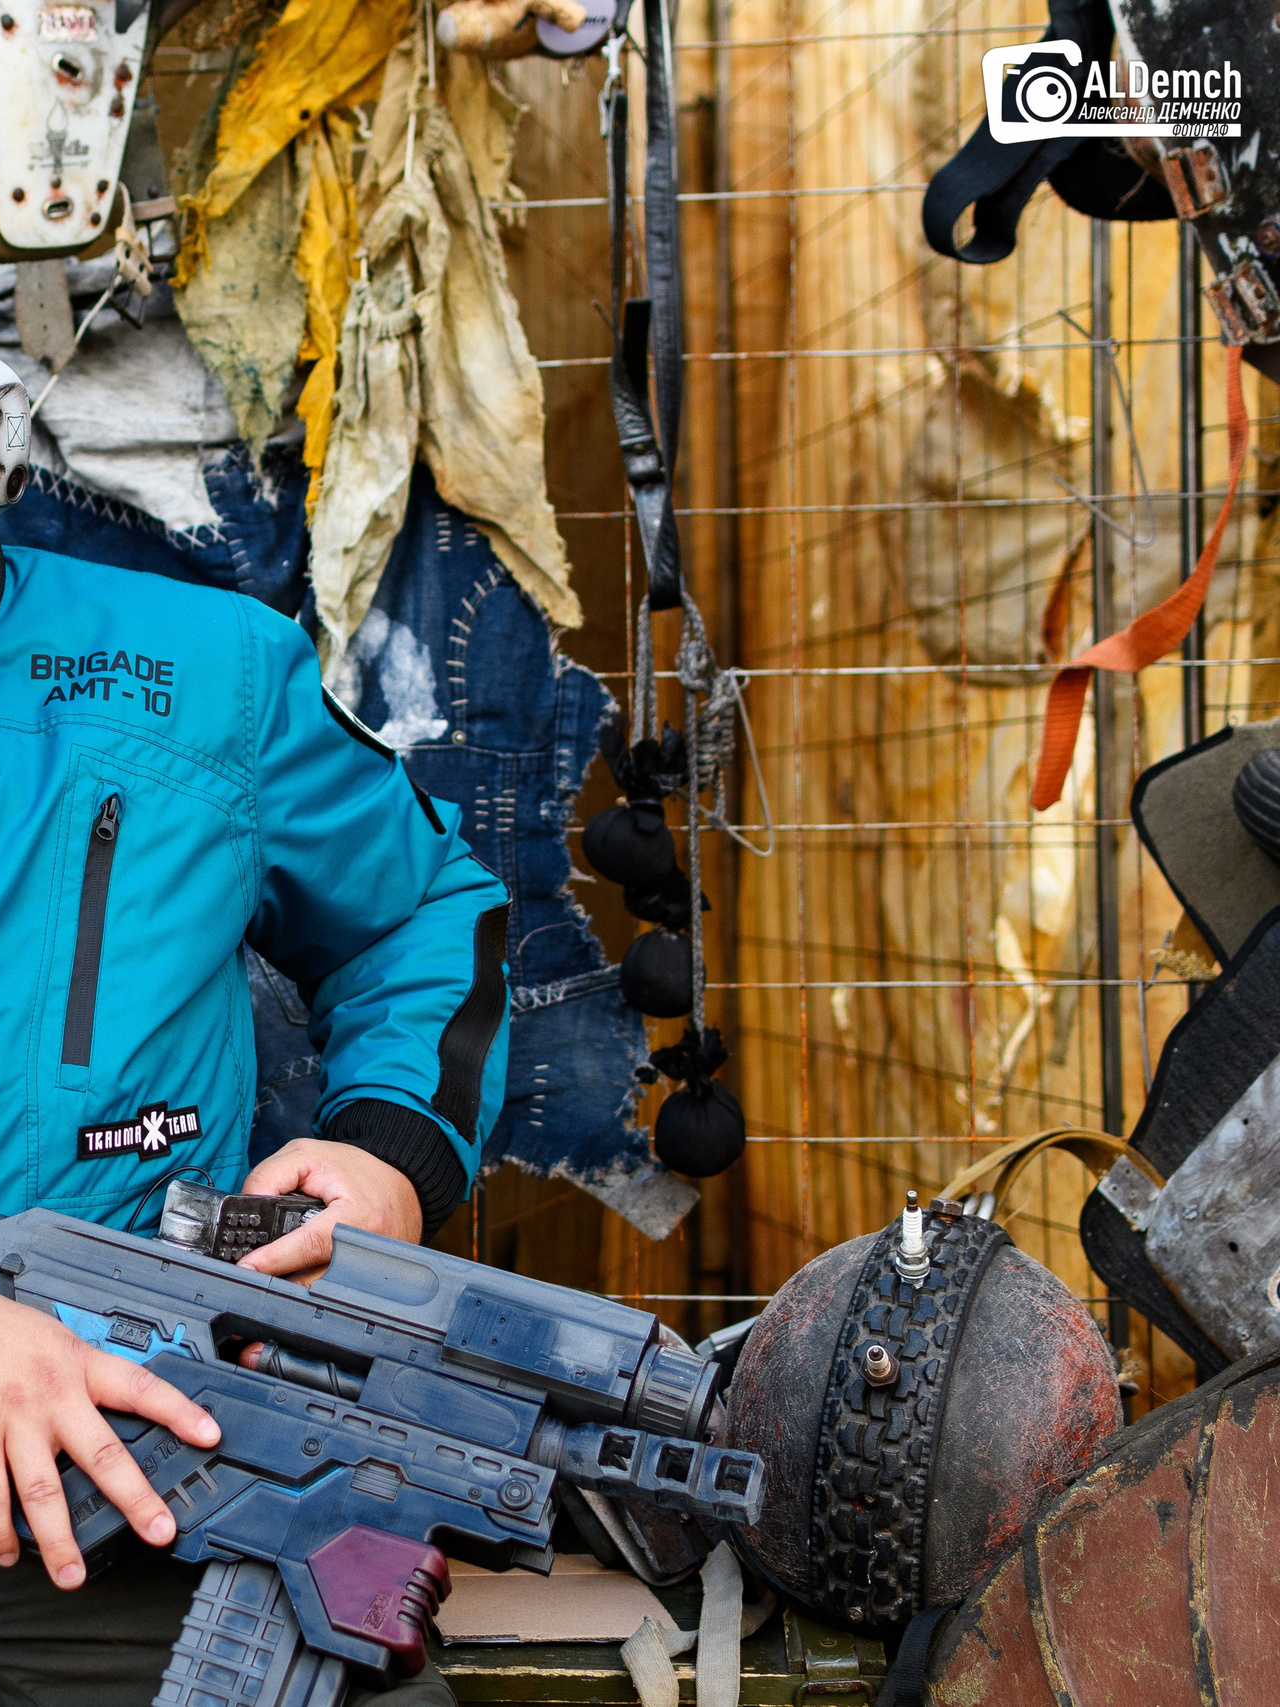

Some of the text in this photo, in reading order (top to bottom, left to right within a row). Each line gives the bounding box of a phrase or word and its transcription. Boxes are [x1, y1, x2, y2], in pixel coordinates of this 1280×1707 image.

[30, 650, 174, 687] BRIGADE
[85, 1113, 198, 1151] TRAUMA TEAM
